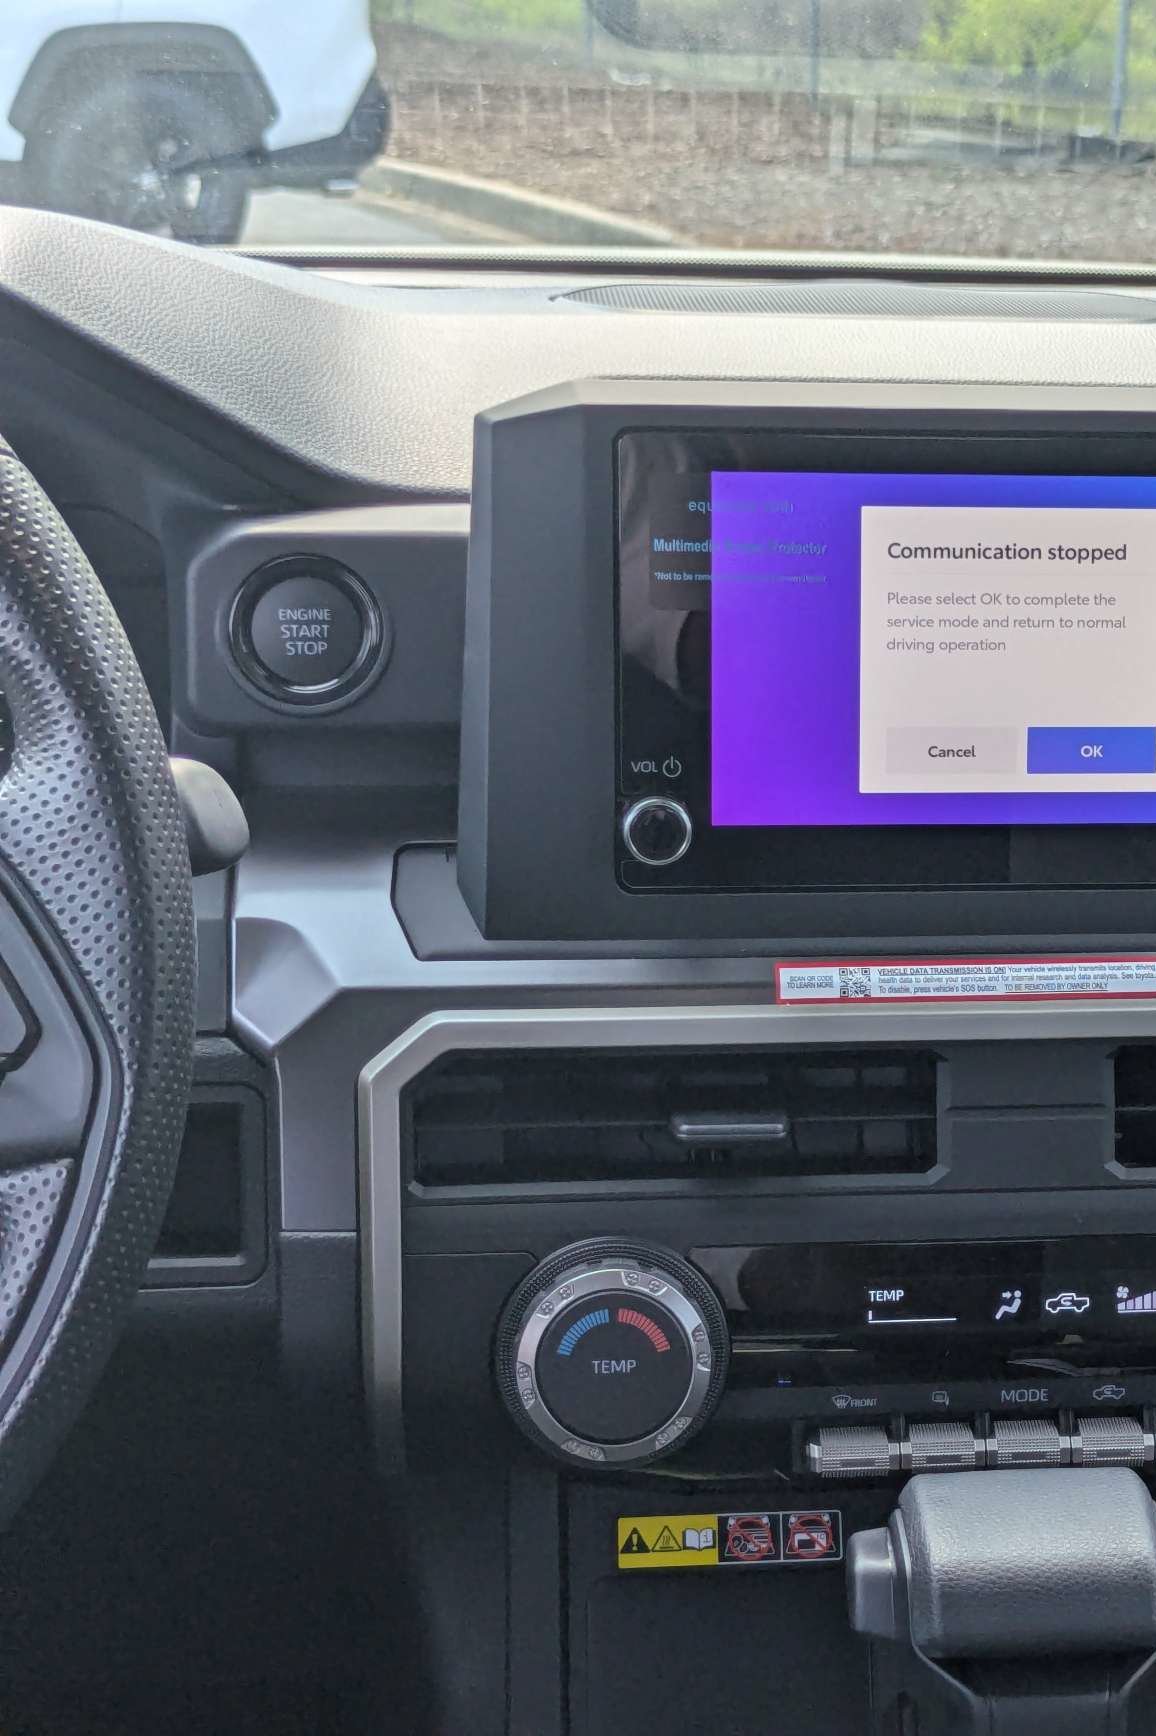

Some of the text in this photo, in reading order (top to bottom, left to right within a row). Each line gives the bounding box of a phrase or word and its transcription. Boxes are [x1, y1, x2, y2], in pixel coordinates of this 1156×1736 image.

[887, 542, 1127, 564] Communication stopped
[887, 592, 1117, 609] Please select OK to complete the
[278, 609, 332, 621] ENGINE
[887, 615, 1127, 629] service mode and return to normal
[280, 624, 330, 639] START
[285, 641, 328, 656] STOP
[886, 638, 1006, 654] driving operation
[927, 745, 977, 758] Cancel
[1080, 745, 1104, 758] OK
[630, 760, 659, 773] VOL
[878, 967, 907, 976] VEHICLE
[910, 967, 929, 975] DATA
[930, 966, 984, 975] TRANSMISSION
[1008, 965, 1022, 973] Your
[1024, 965, 1046, 973] vehicle
[915, 976, 922, 984] to
[945, 976, 959, 984] your
[1005, 983, 1014, 991] TO
[1057, 982, 1066, 990] BY
[1067, 982, 1090, 990] OWNER
[1091, 981, 1108, 990] ONLY
[878, 985, 887, 993] To
[961, 984, 975, 992] SOS
[868, 1289, 905, 1303] TEMP
[591, 1359, 637, 1375] TEMP
[1001, 1388, 1048, 1402] MODE
[849, 1398, 878, 1407] FRONT
